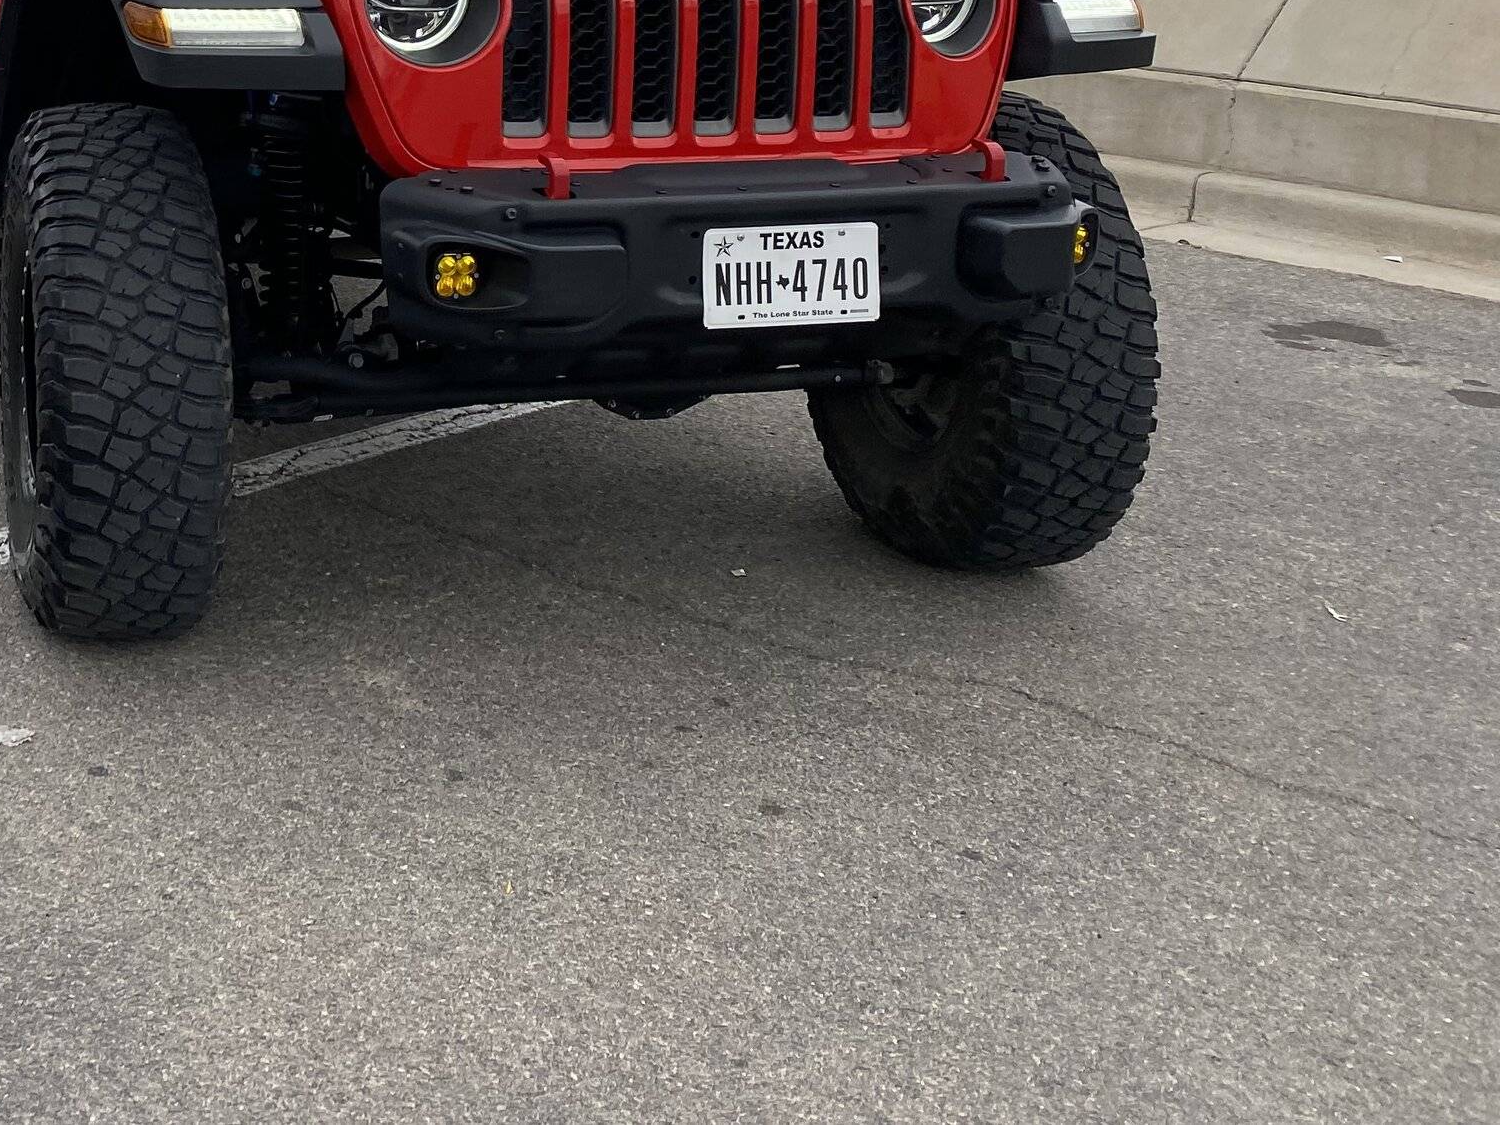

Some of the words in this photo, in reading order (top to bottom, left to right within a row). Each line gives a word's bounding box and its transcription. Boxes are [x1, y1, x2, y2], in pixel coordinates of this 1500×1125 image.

[760, 230, 825, 251] TEXAS
[715, 261, 773, 307] NHH
[792, 257, 869, 303] 4740
[770, 310, 790, 318] Lone
[792, 309, 809, 317] Star
